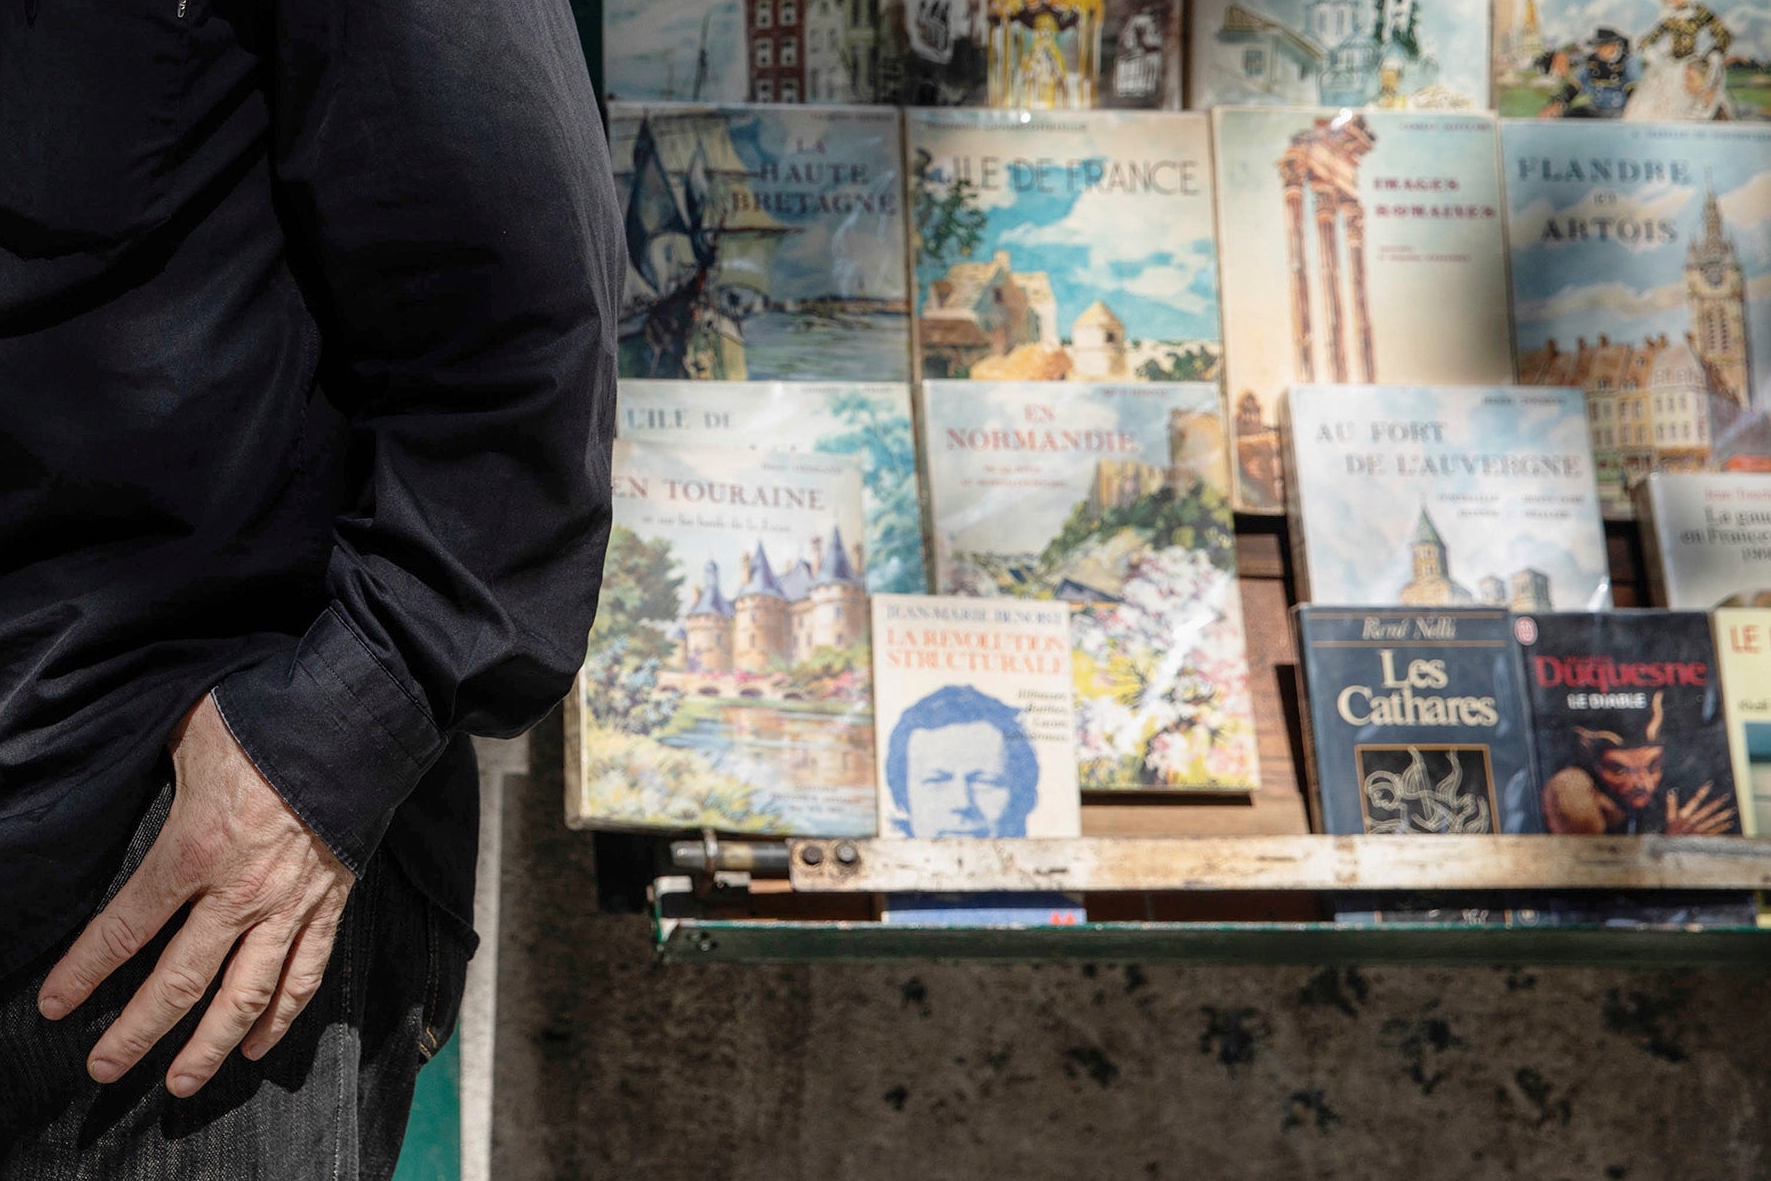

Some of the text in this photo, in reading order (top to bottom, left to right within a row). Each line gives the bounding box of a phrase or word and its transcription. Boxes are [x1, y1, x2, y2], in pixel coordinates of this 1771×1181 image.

[758, 162, 870, 185] HAUTE
[1013, 156, 1056, 195] DE
[1066, 157, 1202, 197] FRANCE
[1517, 156, 1692, 185] FLANDRE
[731, 190, 898, 215] BRETAGNE
[1541, 217, 1678, 244] ARTOIS
[1023, 402, 1057, 424] EN
[945, 426, 1142, 454] NORMANDIE
[1314, 420, 1449, 445] AU FORT
[1344, 453, 1586, 480] DE L'AUVERGNE
[664, 477, 826, 511] TOURAINE
[1730, 623, 1762, 654] LE
[1380, 648, 1450, 690] Les
[1532, 654, 1708, 694] Duquesne
[1336, 685, 1500, 727] Cathares
[1567, 693, 1647, 711] LE DIABLE
